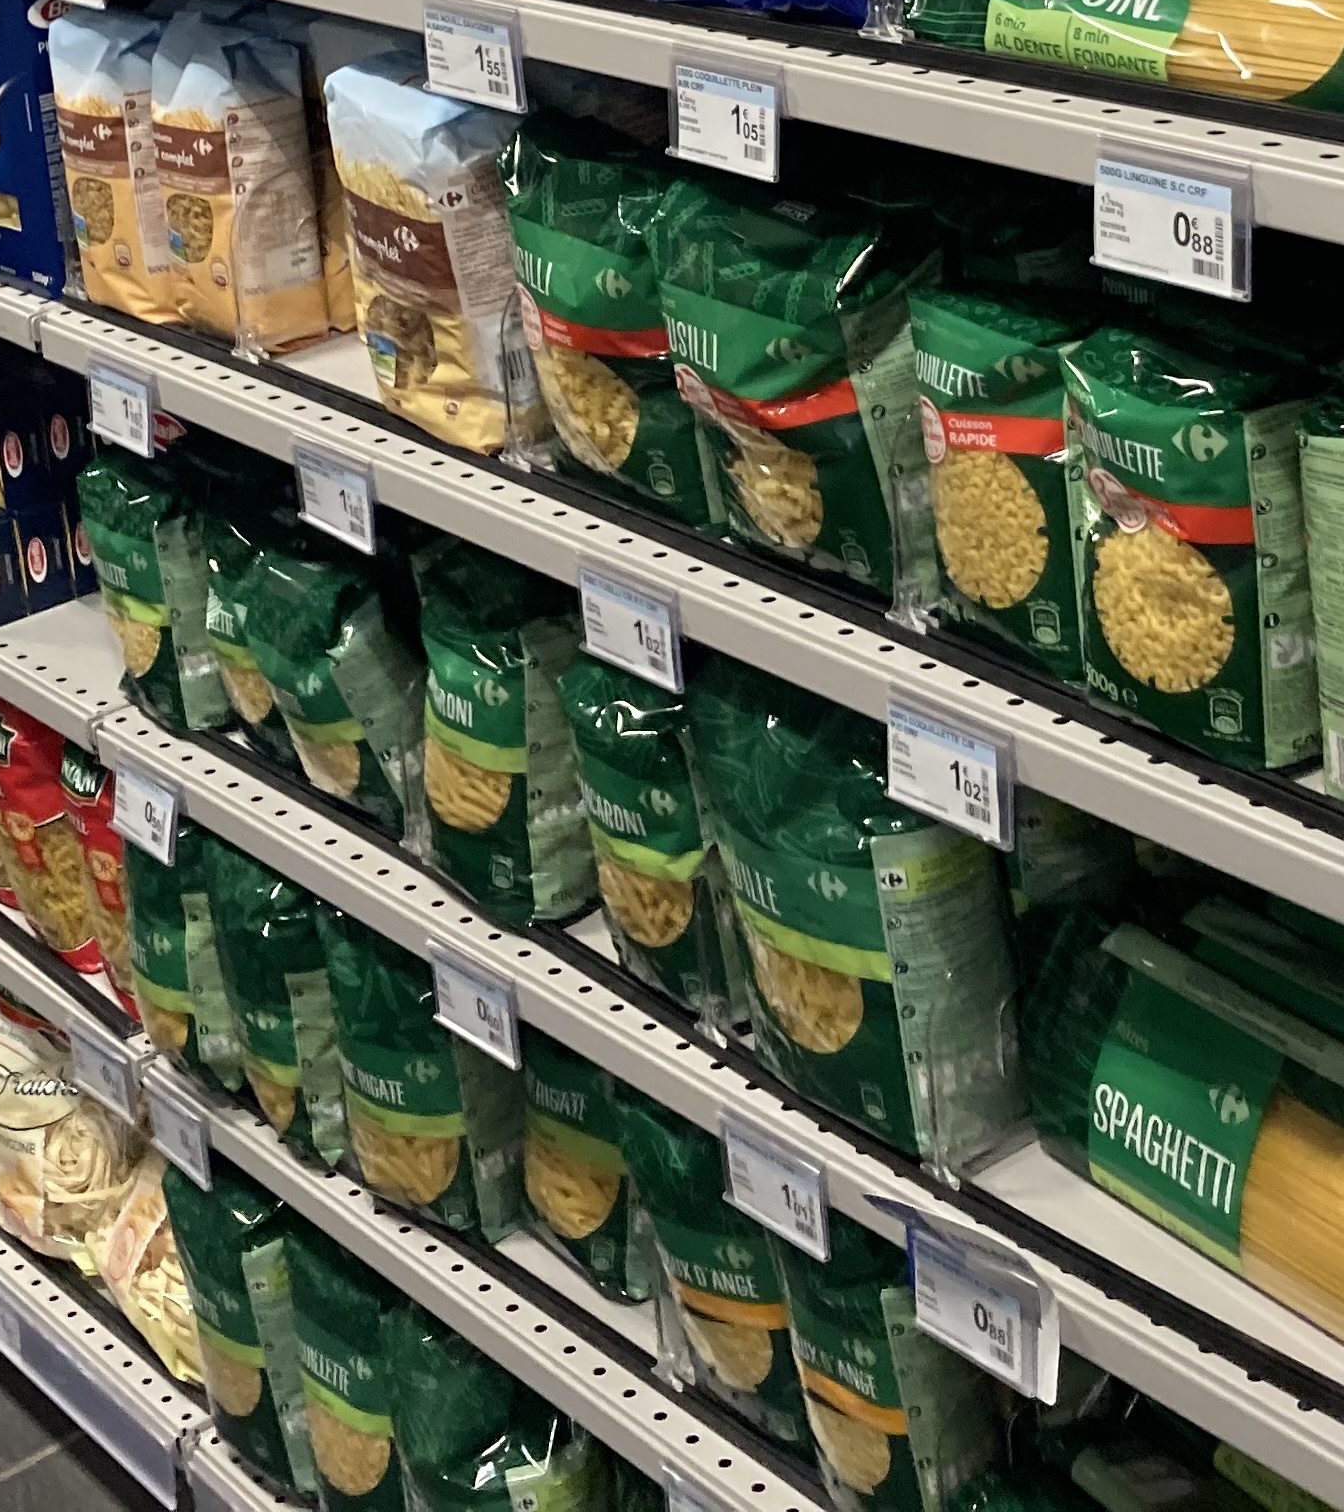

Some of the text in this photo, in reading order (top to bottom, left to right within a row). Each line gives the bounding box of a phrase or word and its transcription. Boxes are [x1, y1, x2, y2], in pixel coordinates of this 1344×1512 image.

[1073, 26, 1109, 45] 8 min
[1012, 35, 1063, 61] DENTE
[1074, 48, 1160, 77] FONDANTE
[948, 418, 993, 431] Cuisson
[949, 431, 998, 448] RAPIDE
[1093, 1082, 1238, 1216] SPAGHETTI
